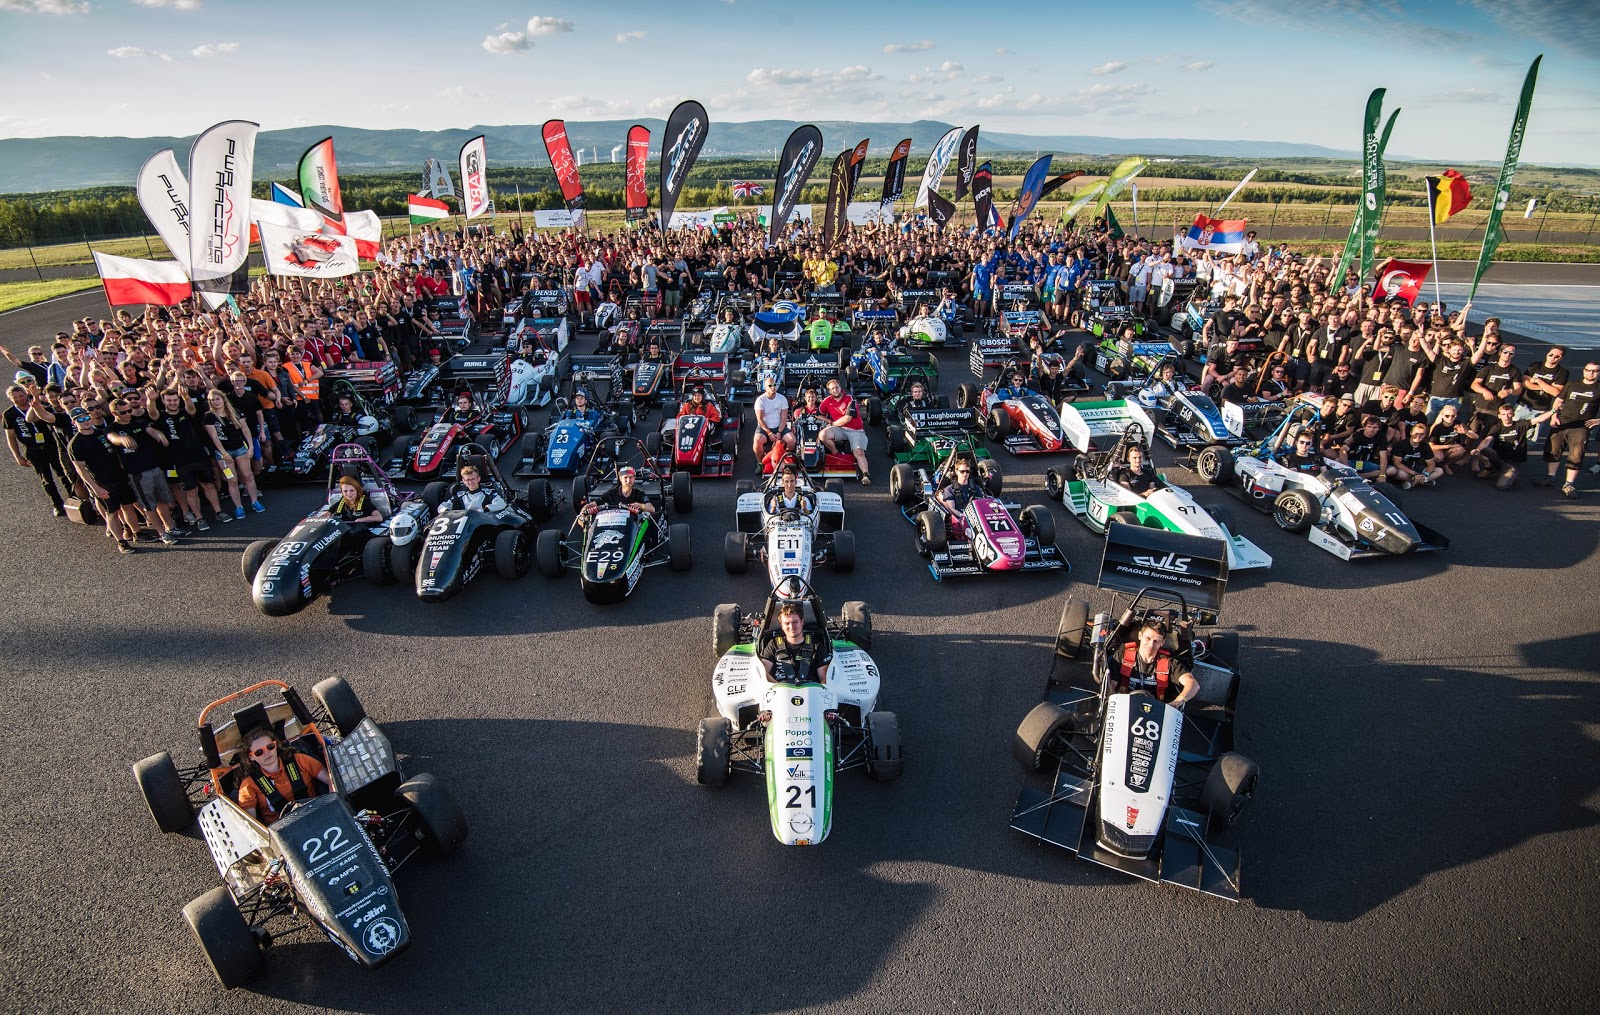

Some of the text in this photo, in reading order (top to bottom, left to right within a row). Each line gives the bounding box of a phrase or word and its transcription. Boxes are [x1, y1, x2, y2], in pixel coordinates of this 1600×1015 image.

[224, 138, 236, 187] PWR
[214, 171, 225, 264] RACING
[1031, 402, 1048, 410] 34
[926, 411, 972, 420] Loughborough
[1080, 409, 1124, 418] CHAEFFLER
[1180, 406, 1193, 421] E68
[556, 434, 569, 444] 23
[1091, 501, 1102, 517] 97
[1178, 505, 1197, 515] 97
[989, 520, 1010, 531] 71
[1385, 512, 1408, 525] 11
[429, 516, 469, 536] 31
[323, 529, 341, 546] Liberec
[778, 540, 799, 549] E11
[275, 543, 305, 555] 69
[978, 537, 986, 556] 71
[1041, 547, 1056, 555] MCT
[586, 551, 624, 563] E29
[1116, 565, 1202, 586] PRAGUE formula racing
[1131, 717, 1160, 741] 68
[786, 764, 806, 778] Volk
[785, 785, 816, 809] 21
[302, 826, 350, 864] 22
[339, 853, 359, 867] KABEL
[335, 890, 377, 919] Feinwerkmechanik
[363, 904, 387, 923] citim
